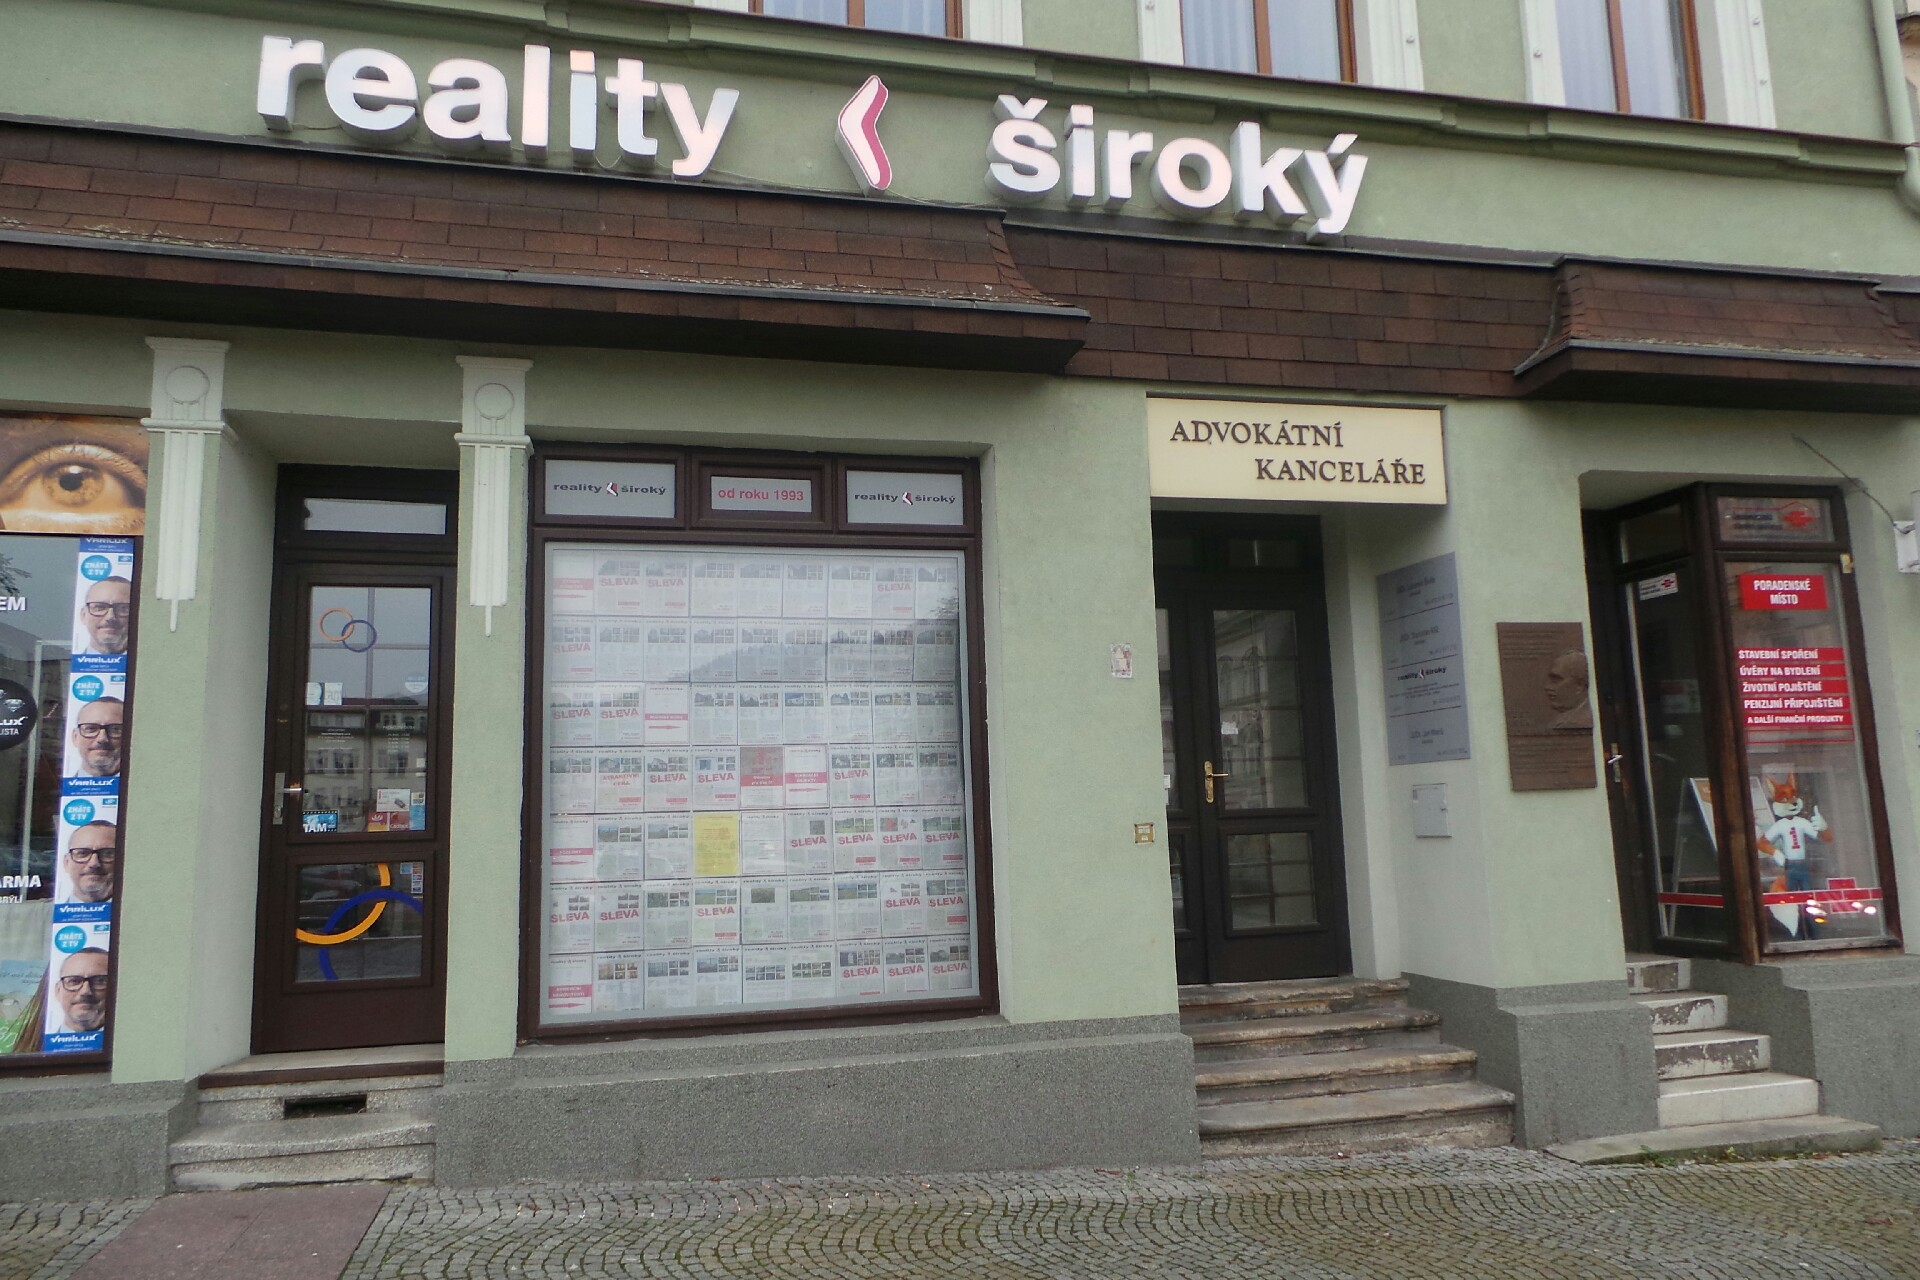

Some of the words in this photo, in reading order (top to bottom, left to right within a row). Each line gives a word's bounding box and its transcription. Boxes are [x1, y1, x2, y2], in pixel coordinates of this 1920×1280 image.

[257, 35, 740, 177] reality
[985, 94, 1368, 238] široký
[1170, 419, 1344, 448] ADVOKÁTNÍ
[1255, 457, 1426, 485] KANCELÁŘE
[553, 483, 602, 493] reality
[621, 484, 666, 495] široký
[718, 488, 735, 499] od
[739, 489, 769, 500] roku
[774, 489, 804, 501] 1993
[854, 492, 898, 502] reality
[915, 494, 955, 504] široký
[600, 577, 638, 587] SLEVA
[647, 578, 685, 588] SLEVA
[877, 583, 911, 592] SLEVA
[1754, 578, 1811, 591] PORADENSKÉ
[1770, 592, 1798, 604] MÍSTO
[553, 643, 591, 653] SLEVA
[1738, 648, 1780, 659] STAVEBNÍ
[1781, 648, 1818, 659] SPOŘENÍ
[1740, 665, 1768, 676] ÚVĚRY
[1770, 667, 1783, 676] NA
[1784, 664, 1820, 675] BYDLENÍ
[1743, 681, 1777, 692] ŽIVOTNÍ
[1778, 681, 1821, 692] POJIŠTĚNÍ
[1744, 698, 1783, 708] PENZIJNÍ
[1784, 697, 1843, 708] PŘIPOJIŠTĚNÍ
[552, 708, 591, 720] SLEVA
[601, 708, 639, 719] SLEVA
[1754, 714, 1774, 723] DALŠÍ
[1775, 714, 1806, 723] FINANČNÍ
[1806, 715, 1843, 723] PRODUKTY
[649, 773, 687, 783] SLEVA
[697, 772, 735, 783] SLEVA
[834, 769, 869, 780] SLEVA
[791, 836, 827, 848] SLEVA
[838, 834, 873, 845] SLEVA
[882, 832, 917, 844] SLEVA
[926, 832, 960, 843] SLEVA
[0, 875, 42, 888] RMA
[885, 897, 920, 908] SLEVA
[929, 896, 964, 907] SLEVA
[600, 909, 639, 921] SLEVA
[697, 906, 735, 917] SLEVA
[551, 912, 590, 923] SLEVA
[843, 966, 879, 978] SLEVA
[889, 965, 924, 977] SLEVA
[933, 963, 968, 974] SLEVA
